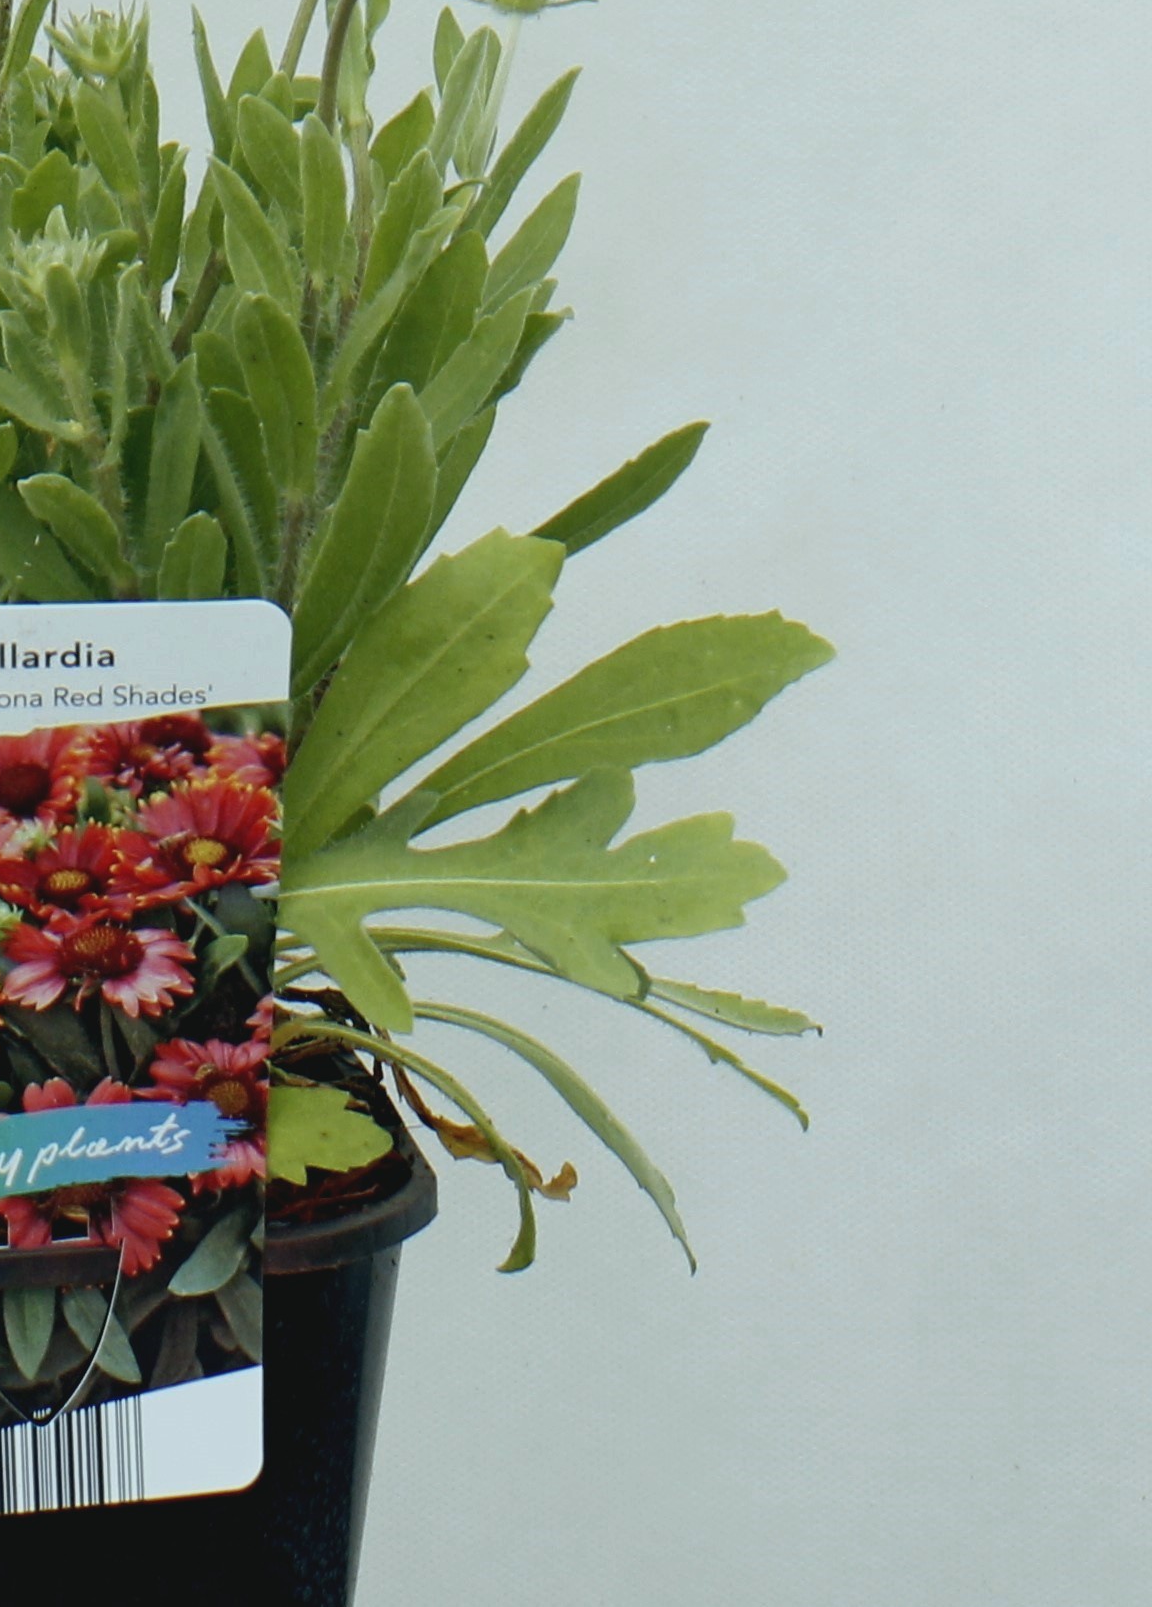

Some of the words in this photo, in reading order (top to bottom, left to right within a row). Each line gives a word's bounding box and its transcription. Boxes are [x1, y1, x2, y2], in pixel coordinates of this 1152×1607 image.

[54, 685, 103, 708] Red
[113, 682, 214, 706] Shades'
[26, 1112, 192, 1184] plants
